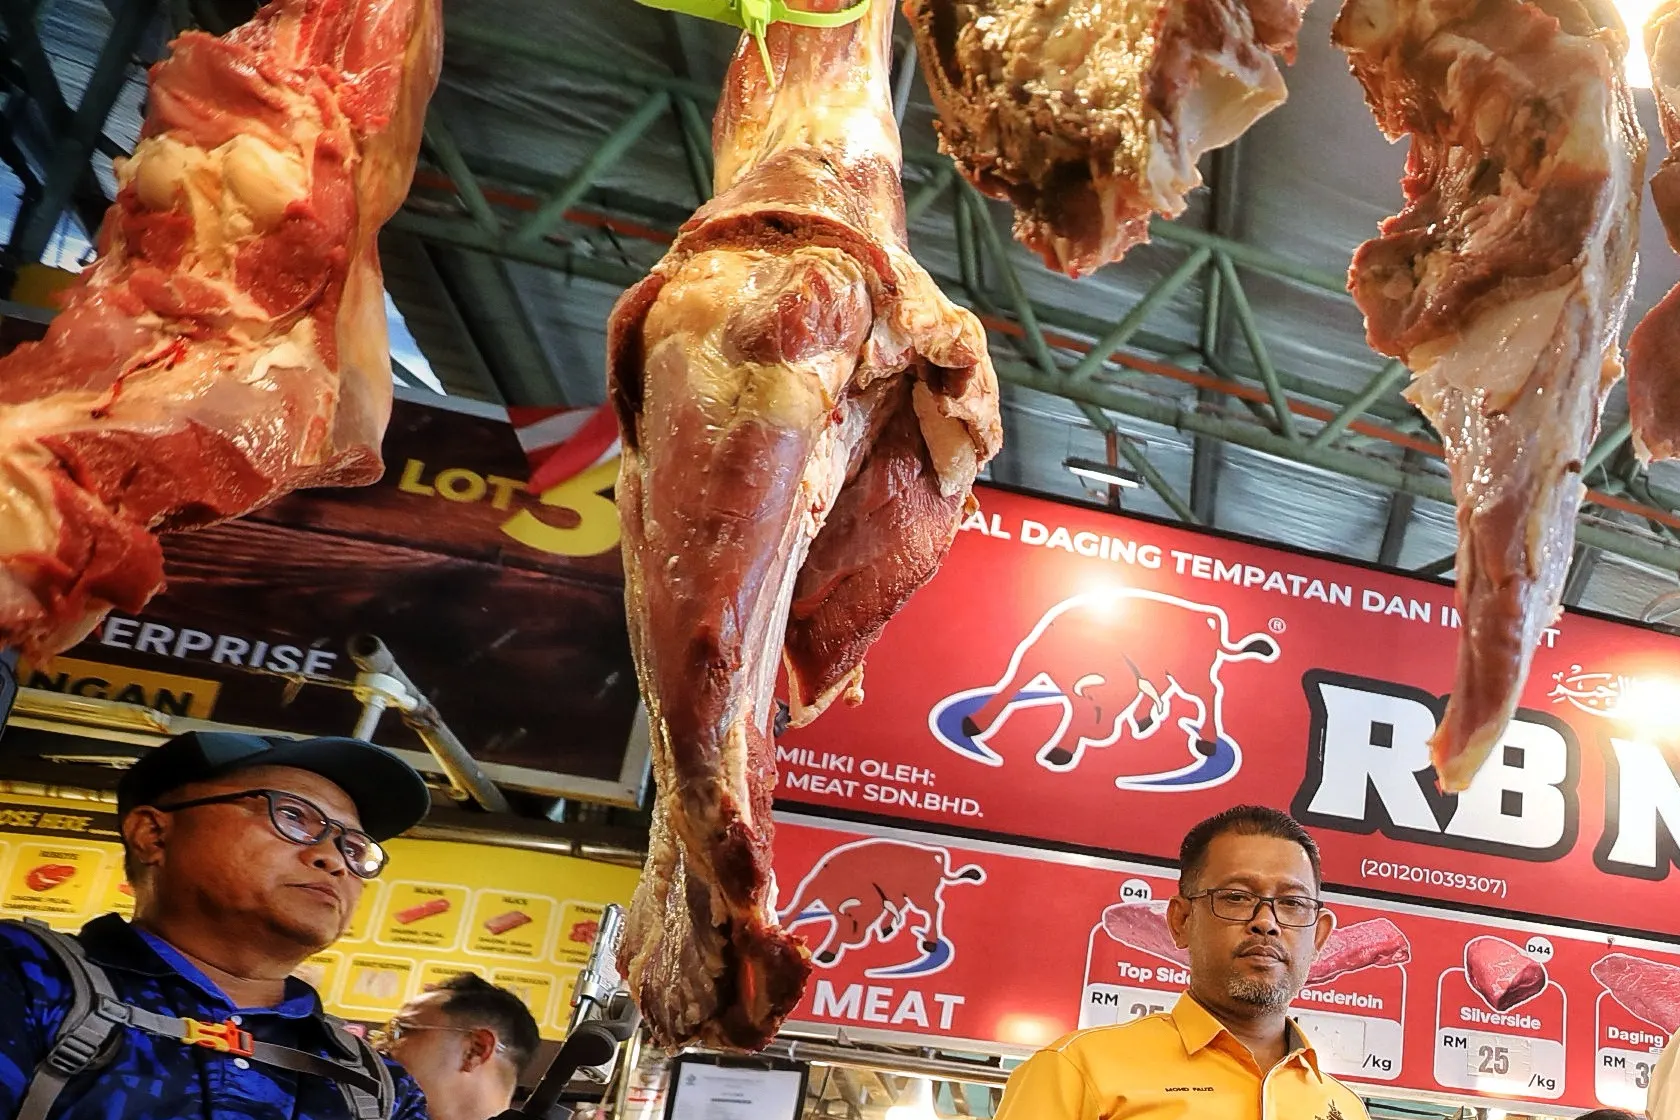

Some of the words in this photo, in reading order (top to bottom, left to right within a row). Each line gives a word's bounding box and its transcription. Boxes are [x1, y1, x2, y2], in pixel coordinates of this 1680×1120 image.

[399, 458, 529, 512] LOT
[1020, 520, 1162, 569] DAGING
[1170, 550, 1352, 607] TEMPATAN
[1362, 589, 1431, 624] DAN
[97, 615, 338, 678] ERPRISE
[860, 759, 936, 787] OLEH:
[1300, 676, 1572, 856] RB
[785, 771, 860, 798] MEAT
[863, 783, 984, 818] SDN.BHD.
[1361, 857, 1508, 899] (201201039307)
[1123, 885, 1148, 900] D41
[1528, 944, 1551, 956] D44
[1117, 961, 1154, 985] Top
[811, 979, 966, 1031] MEAT
[1091, 991, 1119, 1007] RM
[1295, 987, 1384, 1010] enderloin
[1460, 1006, 1542, 1031] Silverside
[1607, 1026, 1664, 1048] Daging
[1362, 1053, 1393, 1072] /kg
[1443, 1035, 1468, 1050] RM
[1478, 1046, 1510, 1075] 25
[1528, 1073, 1556, 1091] /kg
[1603, 1055, 1626, 1069] RM
[1635, 1061, 1656, 1089] 3
